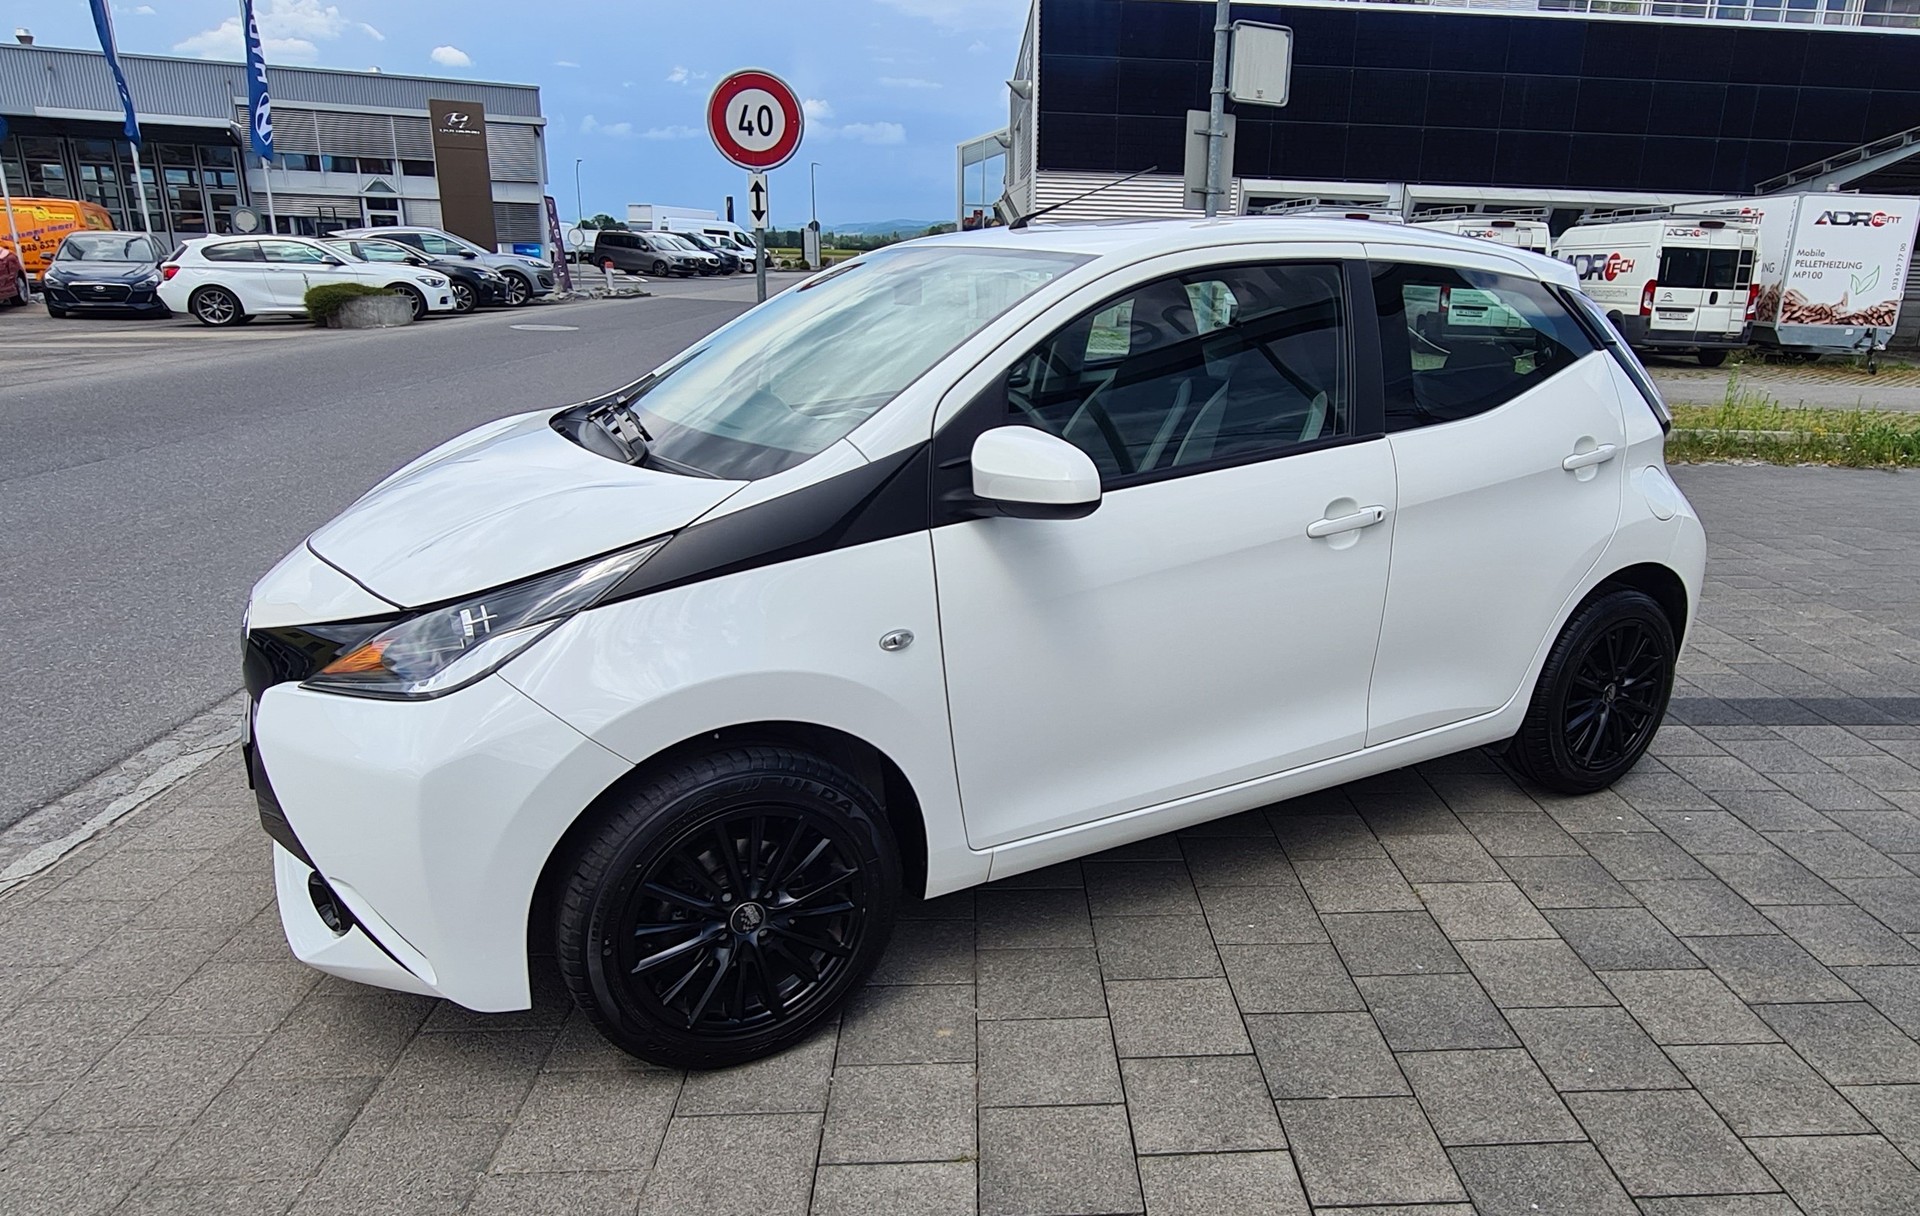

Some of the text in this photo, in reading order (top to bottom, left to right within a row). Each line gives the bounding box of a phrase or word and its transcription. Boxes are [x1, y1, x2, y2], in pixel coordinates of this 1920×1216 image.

[739, 104, 773, 136] 40
[1900, 242, 1907, 252] 00
[1796, 249, 1825, 258] Mobile
[1898, 253, 1905, 262] 77
[1794, 259, 1863, 270] PELLETHEIZUNG
[1792, 271, 1823, 280] MP100
[1891, 276, 1899, 291] 033
